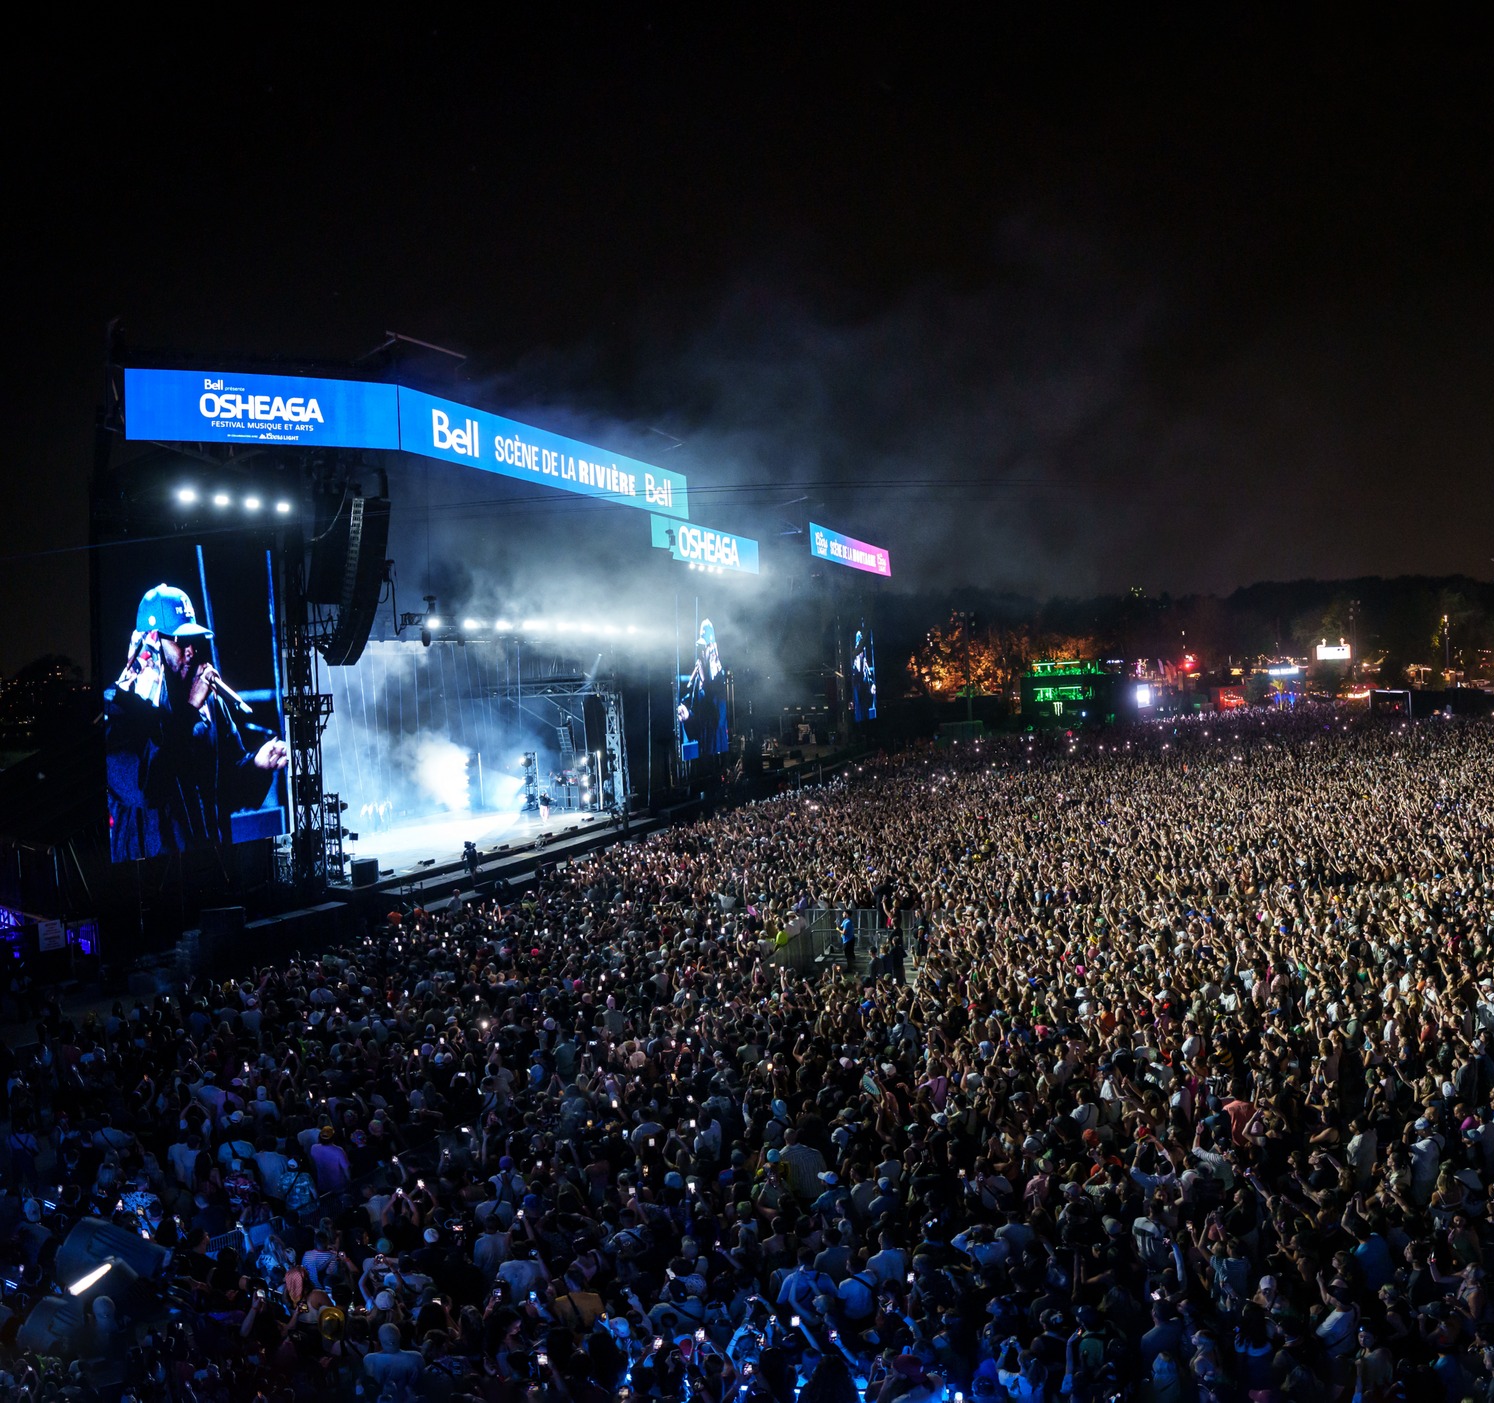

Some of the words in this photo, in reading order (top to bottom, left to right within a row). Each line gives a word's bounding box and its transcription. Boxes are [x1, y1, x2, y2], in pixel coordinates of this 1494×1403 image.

[204, 378, 224, 391] Bell
[199, 393, 324, 423] OSHEAGA
[211, 420, 245, 429] FESTIVAL
[247, 422, 282, 431] MUSIQUE
[284, 423, 293, 431] ET
[295, 424, 314, 432] ARTS
[431, 408, 480, 458] Bell
[494, 434, 540, 472] SCÈNE
[541, 448, 559, 477] DE
[560, 454, 577, 482] LA
[578, 459, 636, 497] RIVIÈRE
[644, 472, 673, 508] Bell
[678, 525, 740, 568] OSHEAGA
